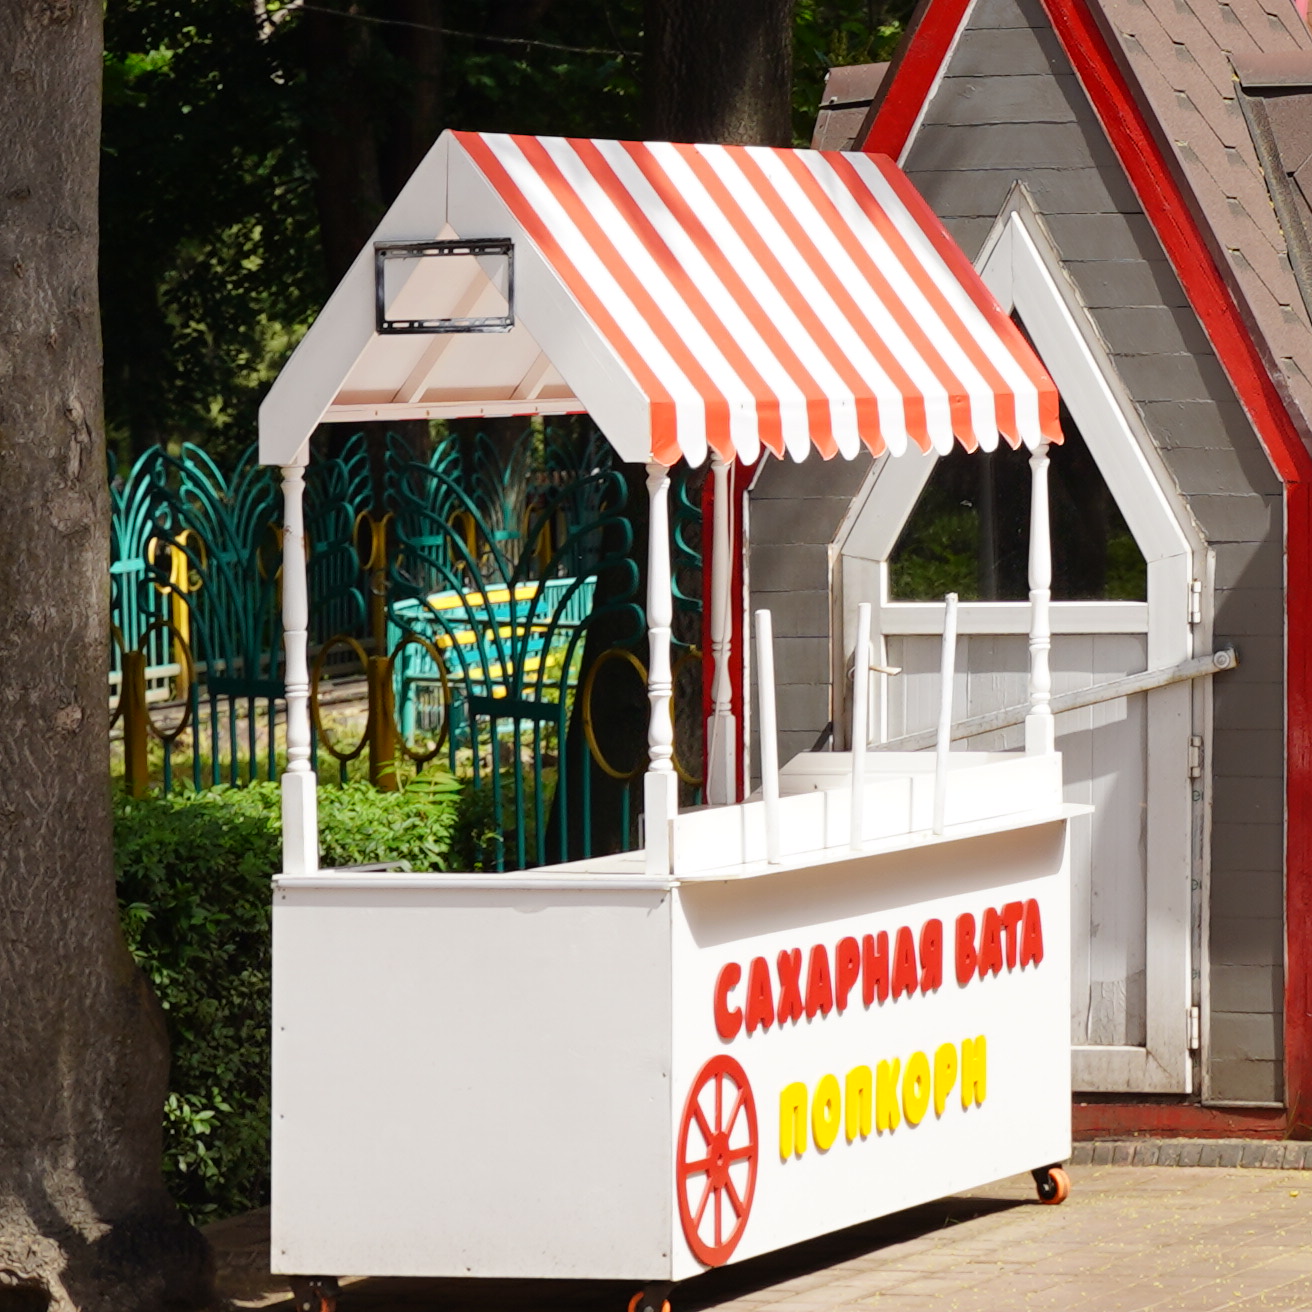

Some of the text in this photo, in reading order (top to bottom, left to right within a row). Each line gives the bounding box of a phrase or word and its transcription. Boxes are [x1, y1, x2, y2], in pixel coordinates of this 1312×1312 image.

[713, 898, 1044, 1040] САХАРНАЯ ВАТА
[779, 1034, 987, 1160] ПОПКОРН
